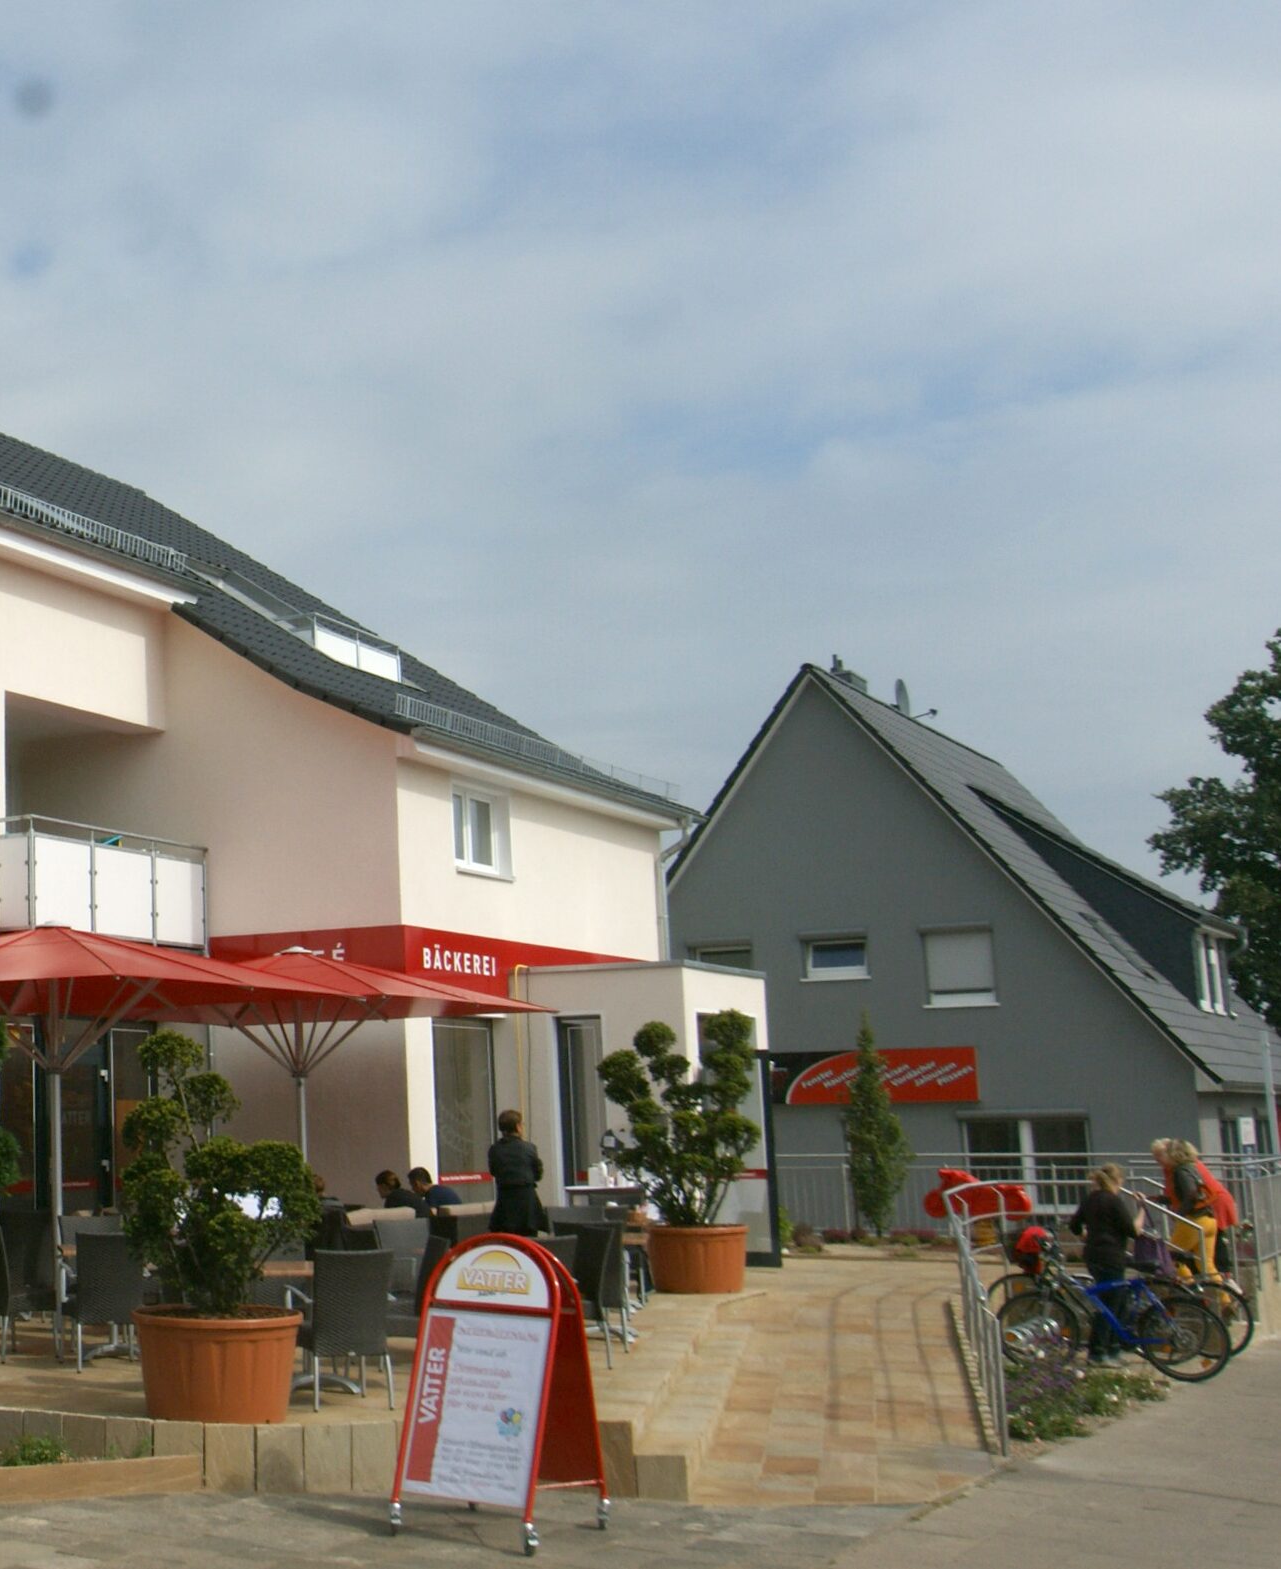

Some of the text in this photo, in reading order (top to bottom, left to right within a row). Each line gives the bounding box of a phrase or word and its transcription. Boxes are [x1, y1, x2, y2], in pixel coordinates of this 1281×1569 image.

[422, 944, 496, 977] BÄCKEREI
[461, 1267, 527, 1291] VATTER
[418, 1346, 446, 1425] VATTER
